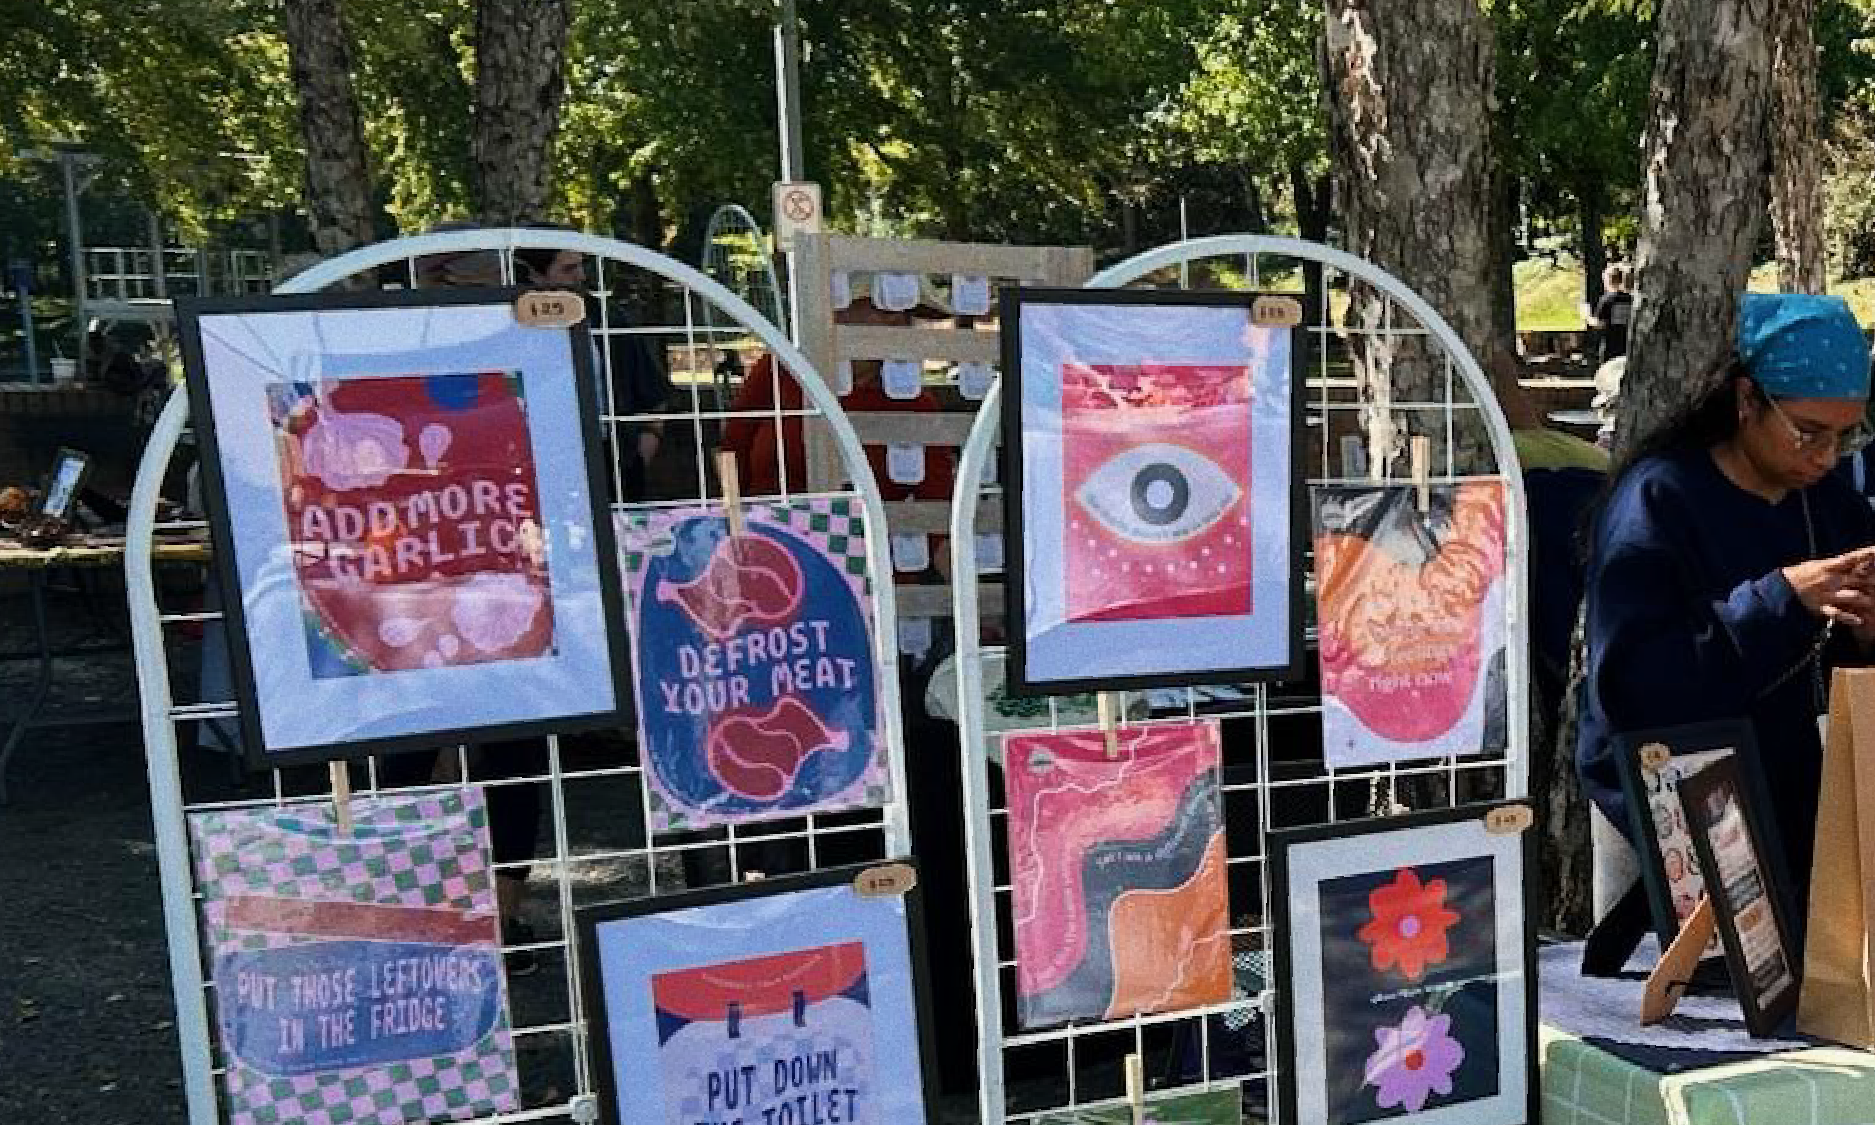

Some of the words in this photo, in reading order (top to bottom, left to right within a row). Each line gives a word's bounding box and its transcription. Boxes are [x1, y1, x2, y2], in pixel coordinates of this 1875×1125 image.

[303, 502, 398, 541] ADD
[408, 480, 531, 528] MORE
[329, 520, 520, 590] GARLIC
[679, 620, 829, 678] DEFROST
[660, 675, 750, 714] YOUR
[771, 656, 856, 697] MEAT
[237, 972, 277, 1010] PUT
[290, 968, 357, 1011] THOSE
[370, 954, 484, 998] LEFTOVERS
[278, 1018, 304, 1053] IN
[318, 1009, 355, 1050] THE
[370, 997, 447, 1040] FRIDGE
[708, 1064, 757, 1111] PUT
[774, 1049, 838, 1096] DOWN
